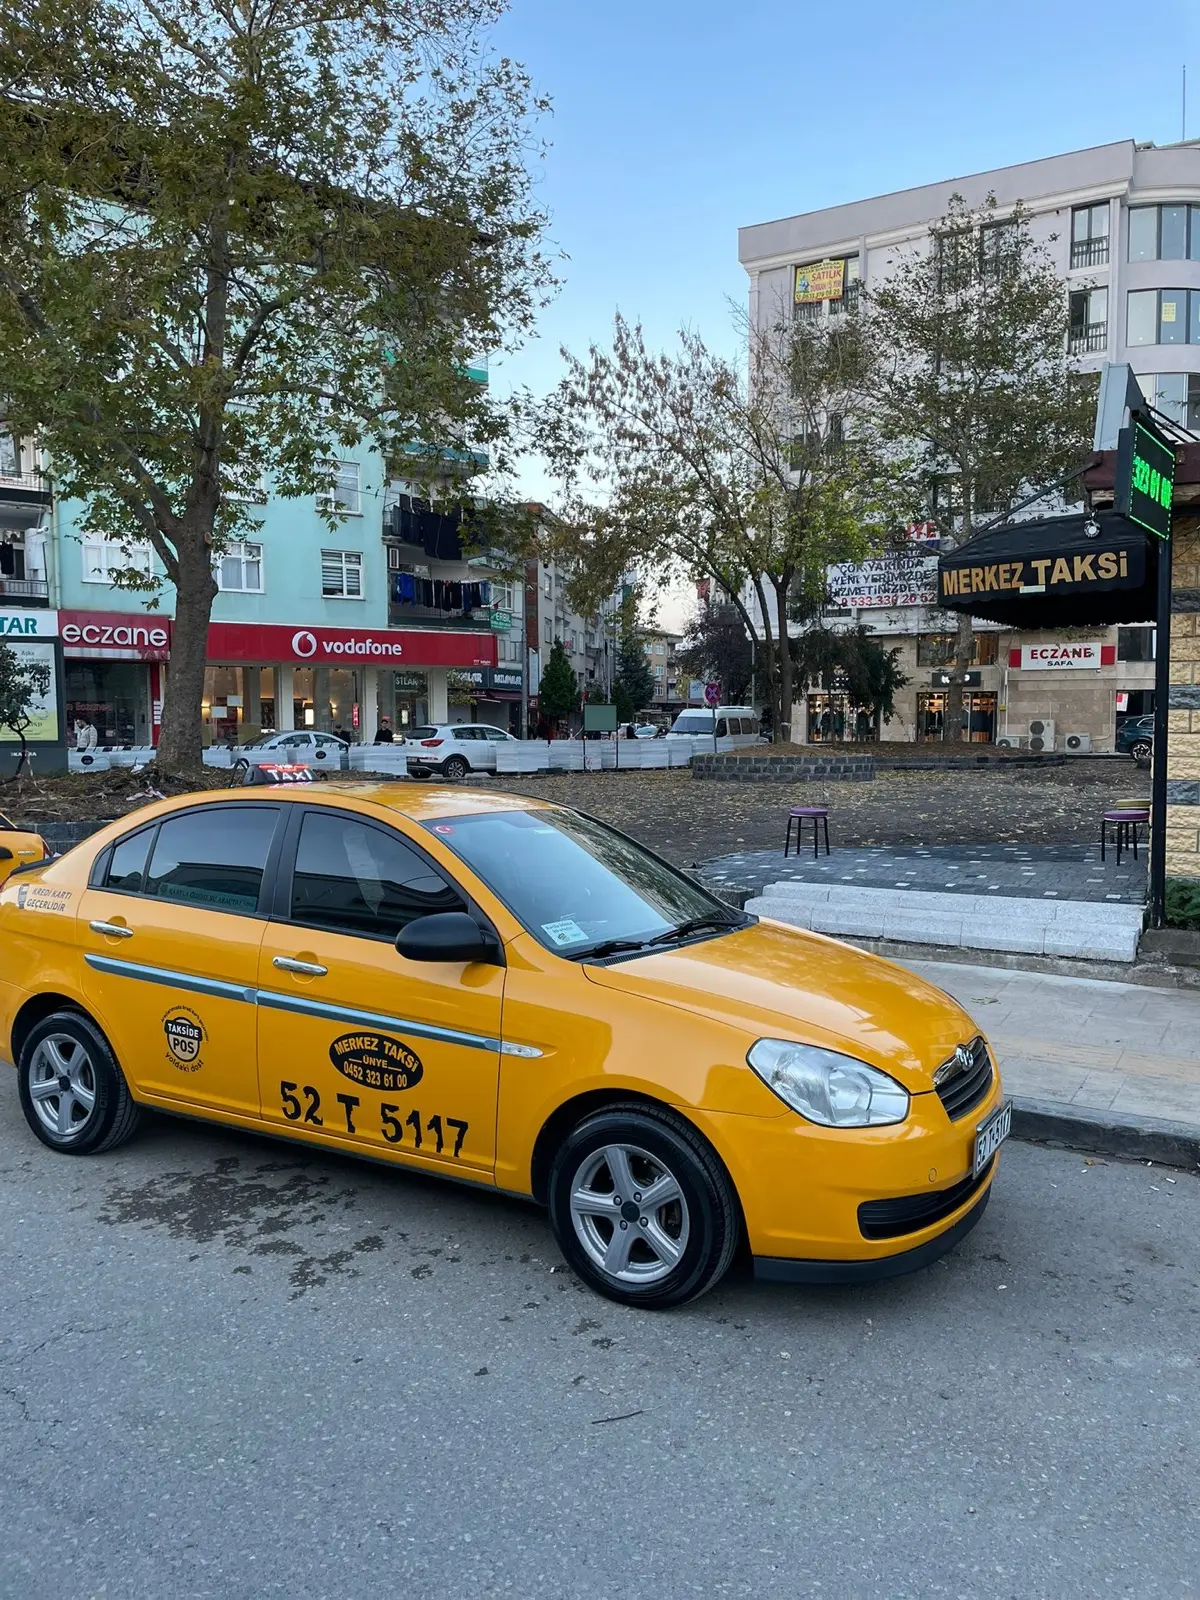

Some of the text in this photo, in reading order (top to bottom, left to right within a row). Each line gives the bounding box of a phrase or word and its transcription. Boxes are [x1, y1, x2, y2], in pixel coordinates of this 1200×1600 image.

[812, 270, 841, 281] SATILIK
[840, 558, 924, 576] ÇOK YAKINDA
[943, 563, 1024, 596] MERKEZ
[851, 596, 873, 606] 533
[62, 623, 168, 647] eczane
[322, 638, 402, 655] vodafone
[1031, 648, 1091, 659] ECZANE
[267, 769, 312, 780] TAXI
[167, 1023, 199, 1038] TAKSİDE
[173, 1037, 195, 1054] POS
[334, 1037, 379, 1055] MERKEZ
[165, 1051, 204, 1072] yoldaki dost
[363, 1055, 388, 1068] ÜNYE
[343, 1060, 408, 1087] 0452 323 61 00
[280, 1080, 469, 1158] 52 T 5117
